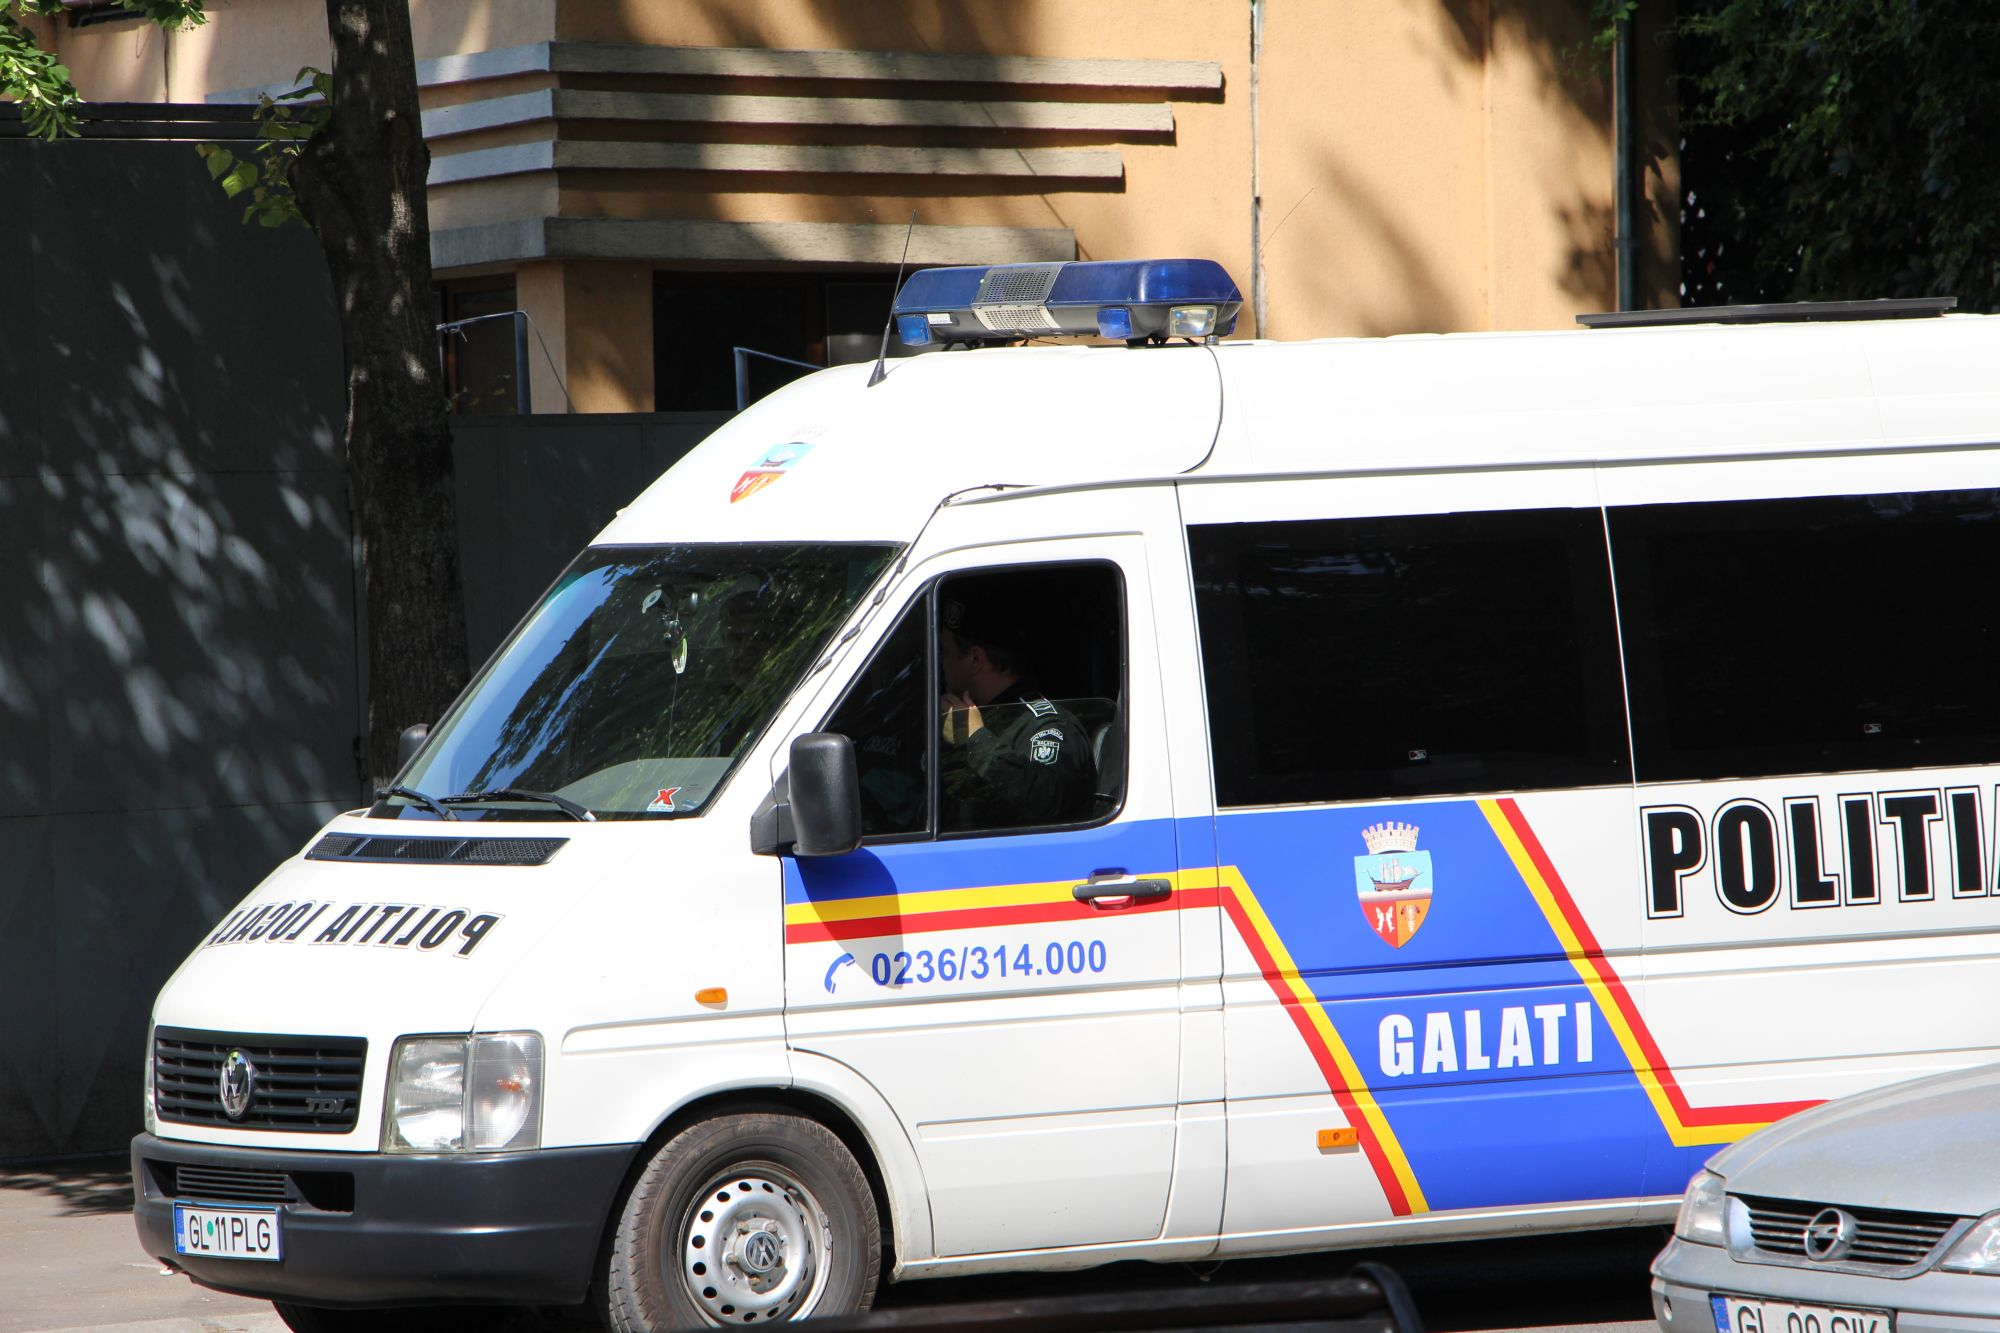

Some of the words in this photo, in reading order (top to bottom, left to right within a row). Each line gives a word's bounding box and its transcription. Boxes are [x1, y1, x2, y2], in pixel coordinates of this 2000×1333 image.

[1640, 784, 2000, 919] POLITI
[871, 940, 1107, 986] 0236/314.000
[1378, 1001, 1593, 1078] GALATI
[305, 1098, 345, 1114] TDI
[189, 1215, 209, 1250] GL
[215, 1216, 227, 1251] 11
[231, 1217, 271, 1252] PLG
